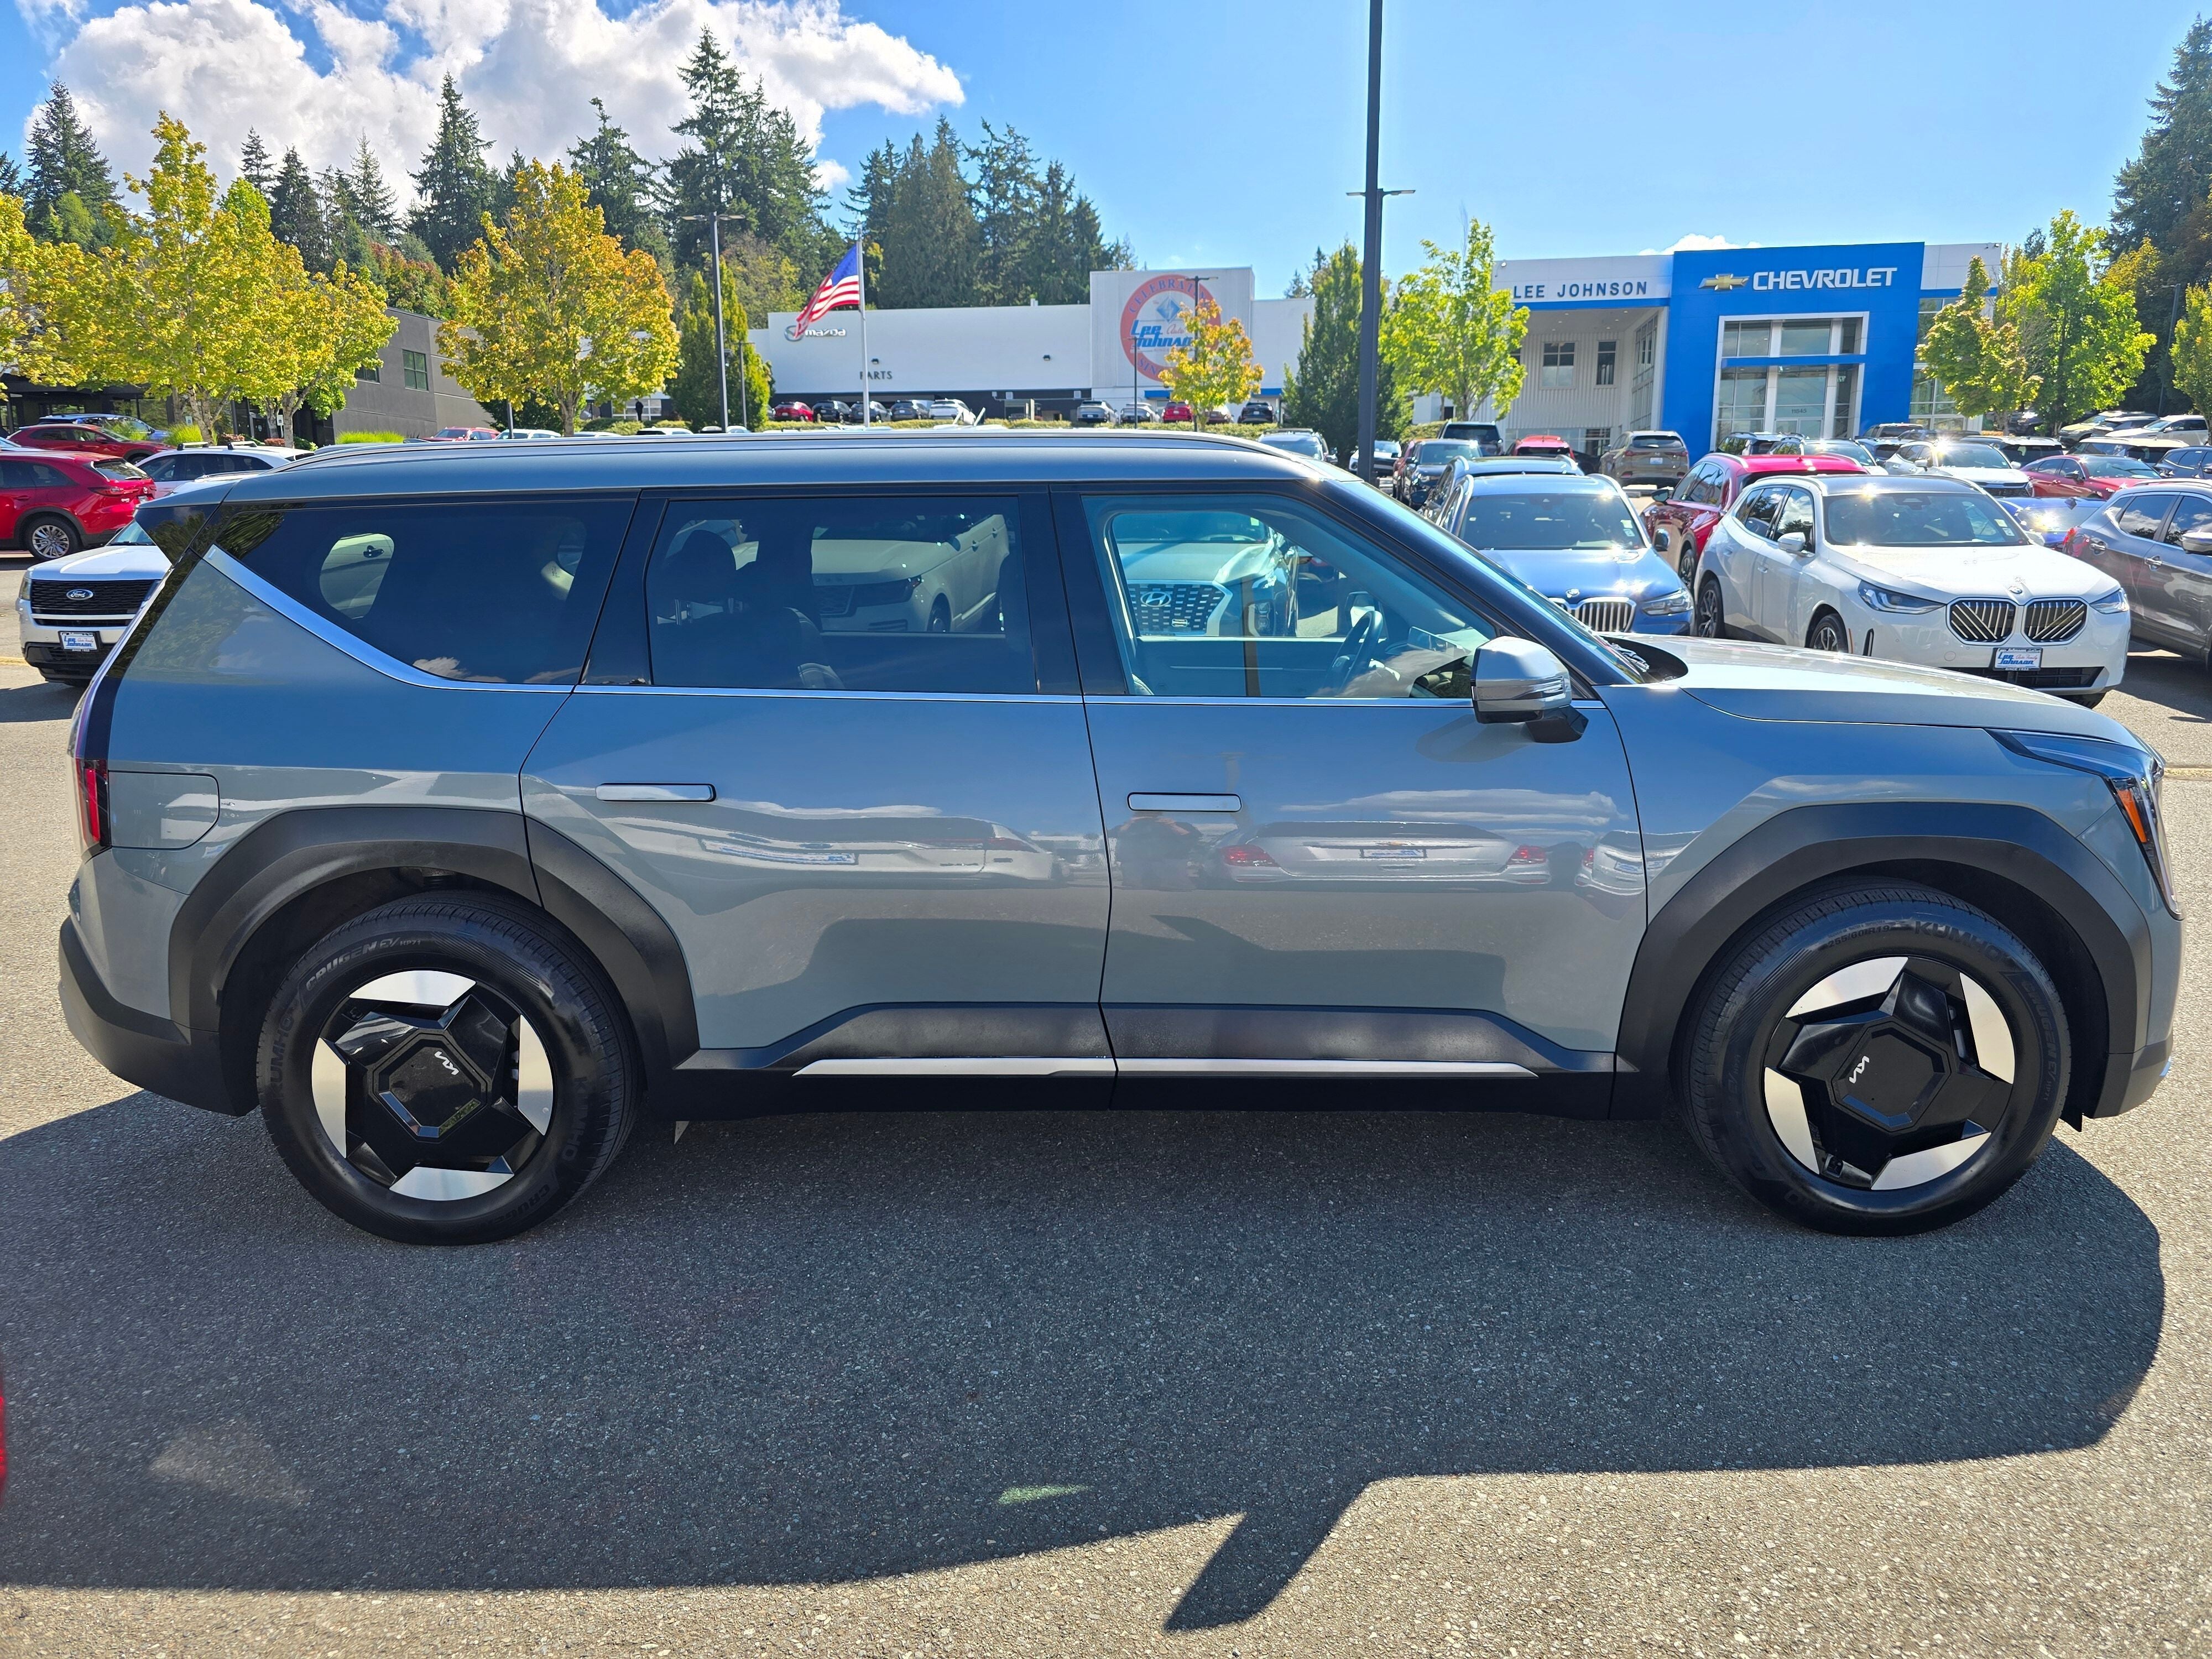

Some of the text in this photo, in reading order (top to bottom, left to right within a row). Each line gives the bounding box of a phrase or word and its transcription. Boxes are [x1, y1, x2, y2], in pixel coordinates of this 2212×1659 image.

[1513, 281, 1647, 299] LEE JOHNSON
[1752, 267, 1897, 290] CHEVROLET
[1129, 279, 1206, 313] CELEBRAT
[805, 328, 846, 337] mazda
[1133, 335, 1193, 347] Johnso
[1914, 921, 2002, 961] KUMHO
[305, 940, 378, 992] CRUGEN
[269, 1014, 294, 1098] KUMHO
